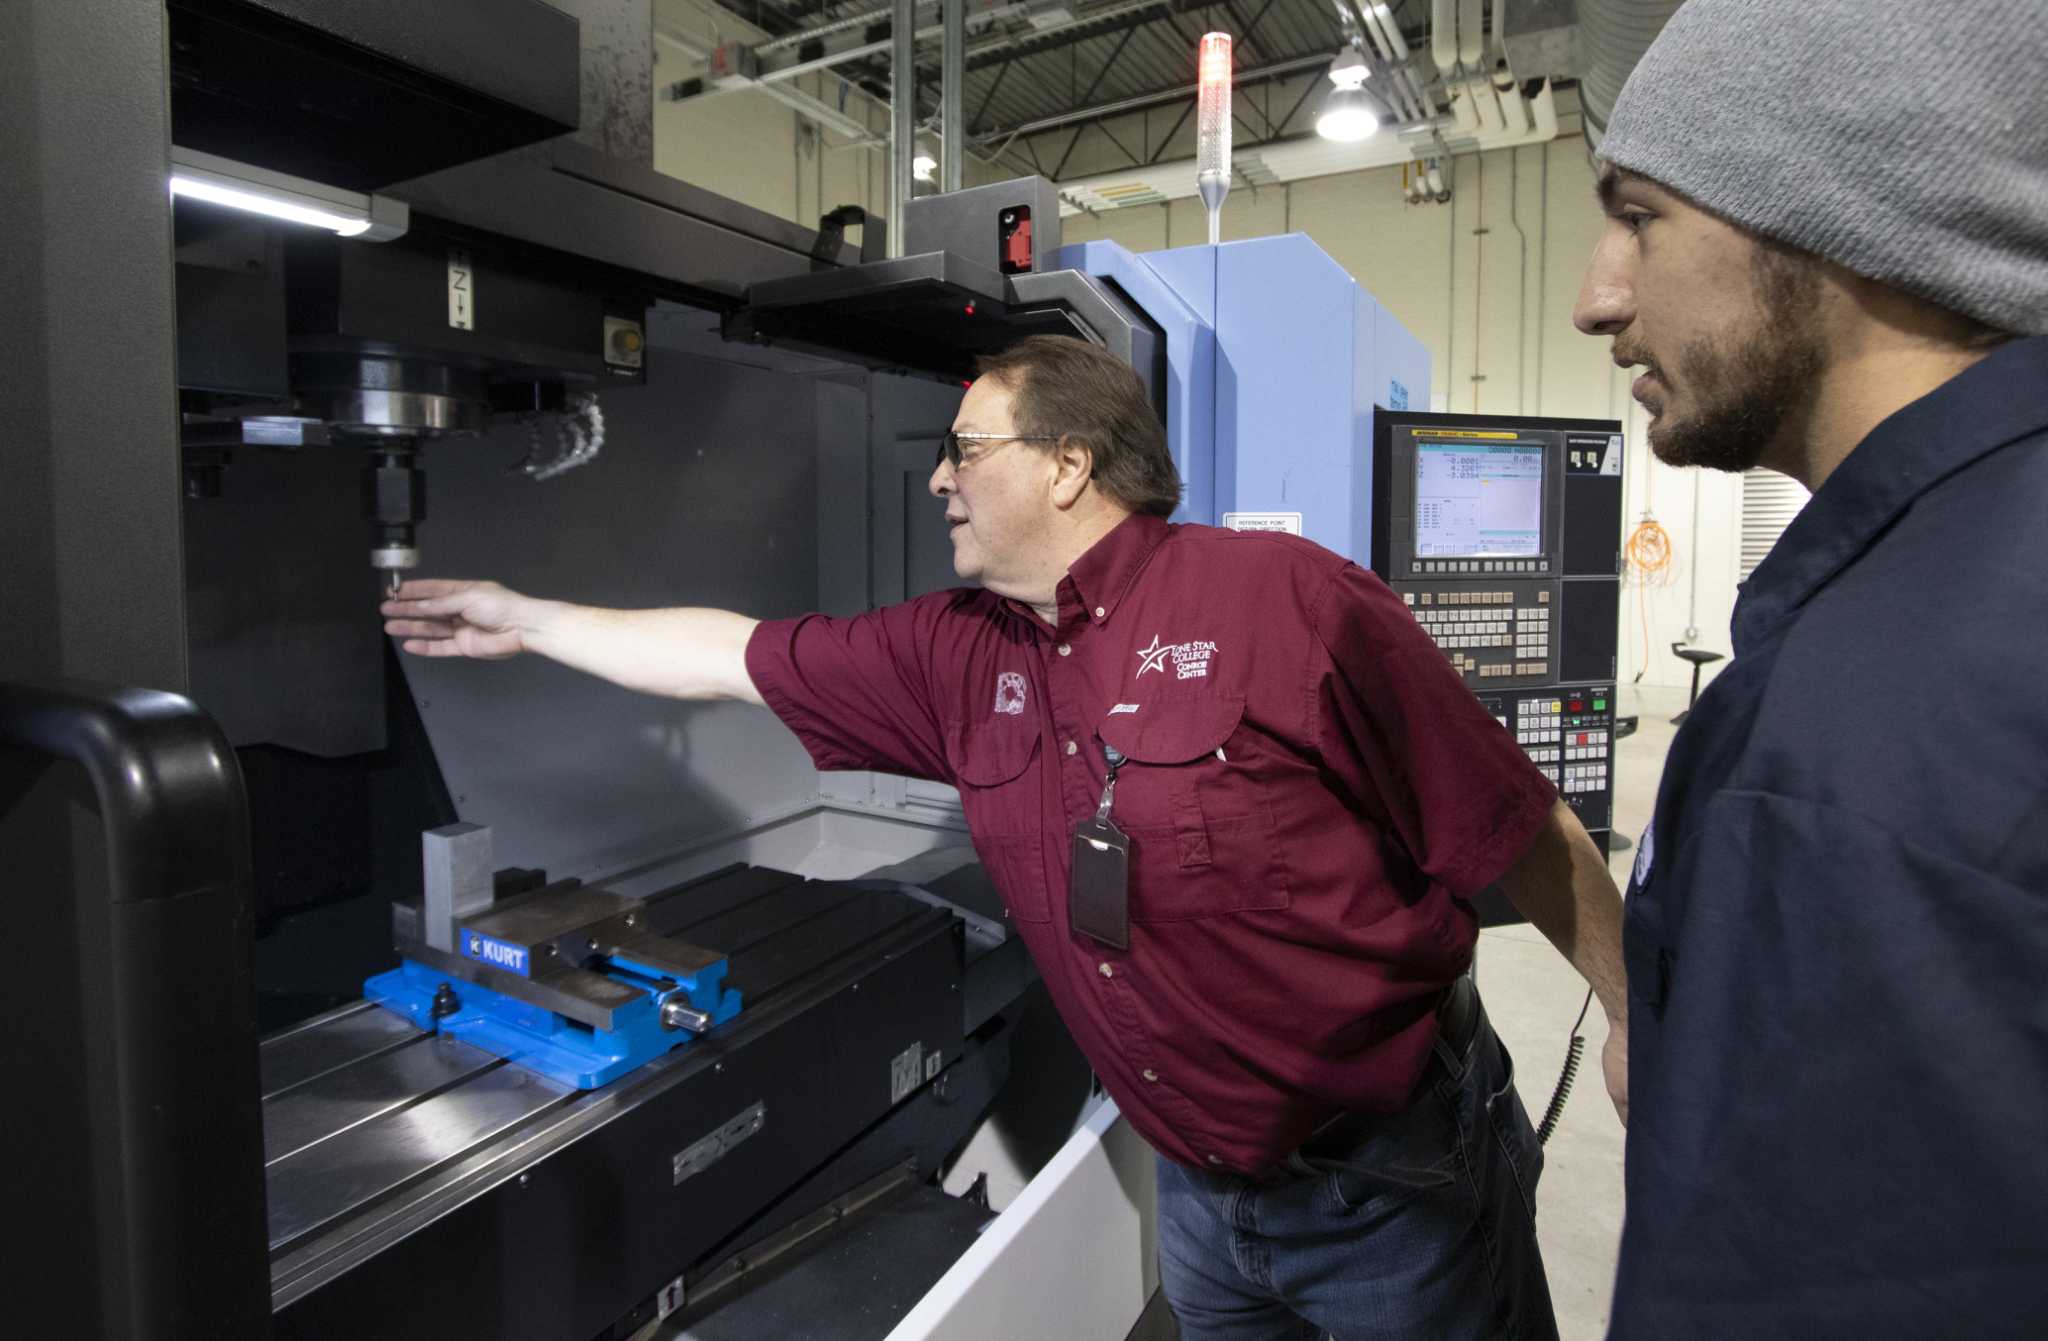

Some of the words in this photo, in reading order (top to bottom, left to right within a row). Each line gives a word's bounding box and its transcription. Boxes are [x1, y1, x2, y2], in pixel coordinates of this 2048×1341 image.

[453, 270, 466, 291] Z
[1170, 643, 1192, 657] LONE
[1192, 640, 1219, 652] STAR
[1172, 650, 1211, 664] COLLEGE
[1177, 669, 1207, 680] CENTER
[483, 939, 523, 969] KURT
